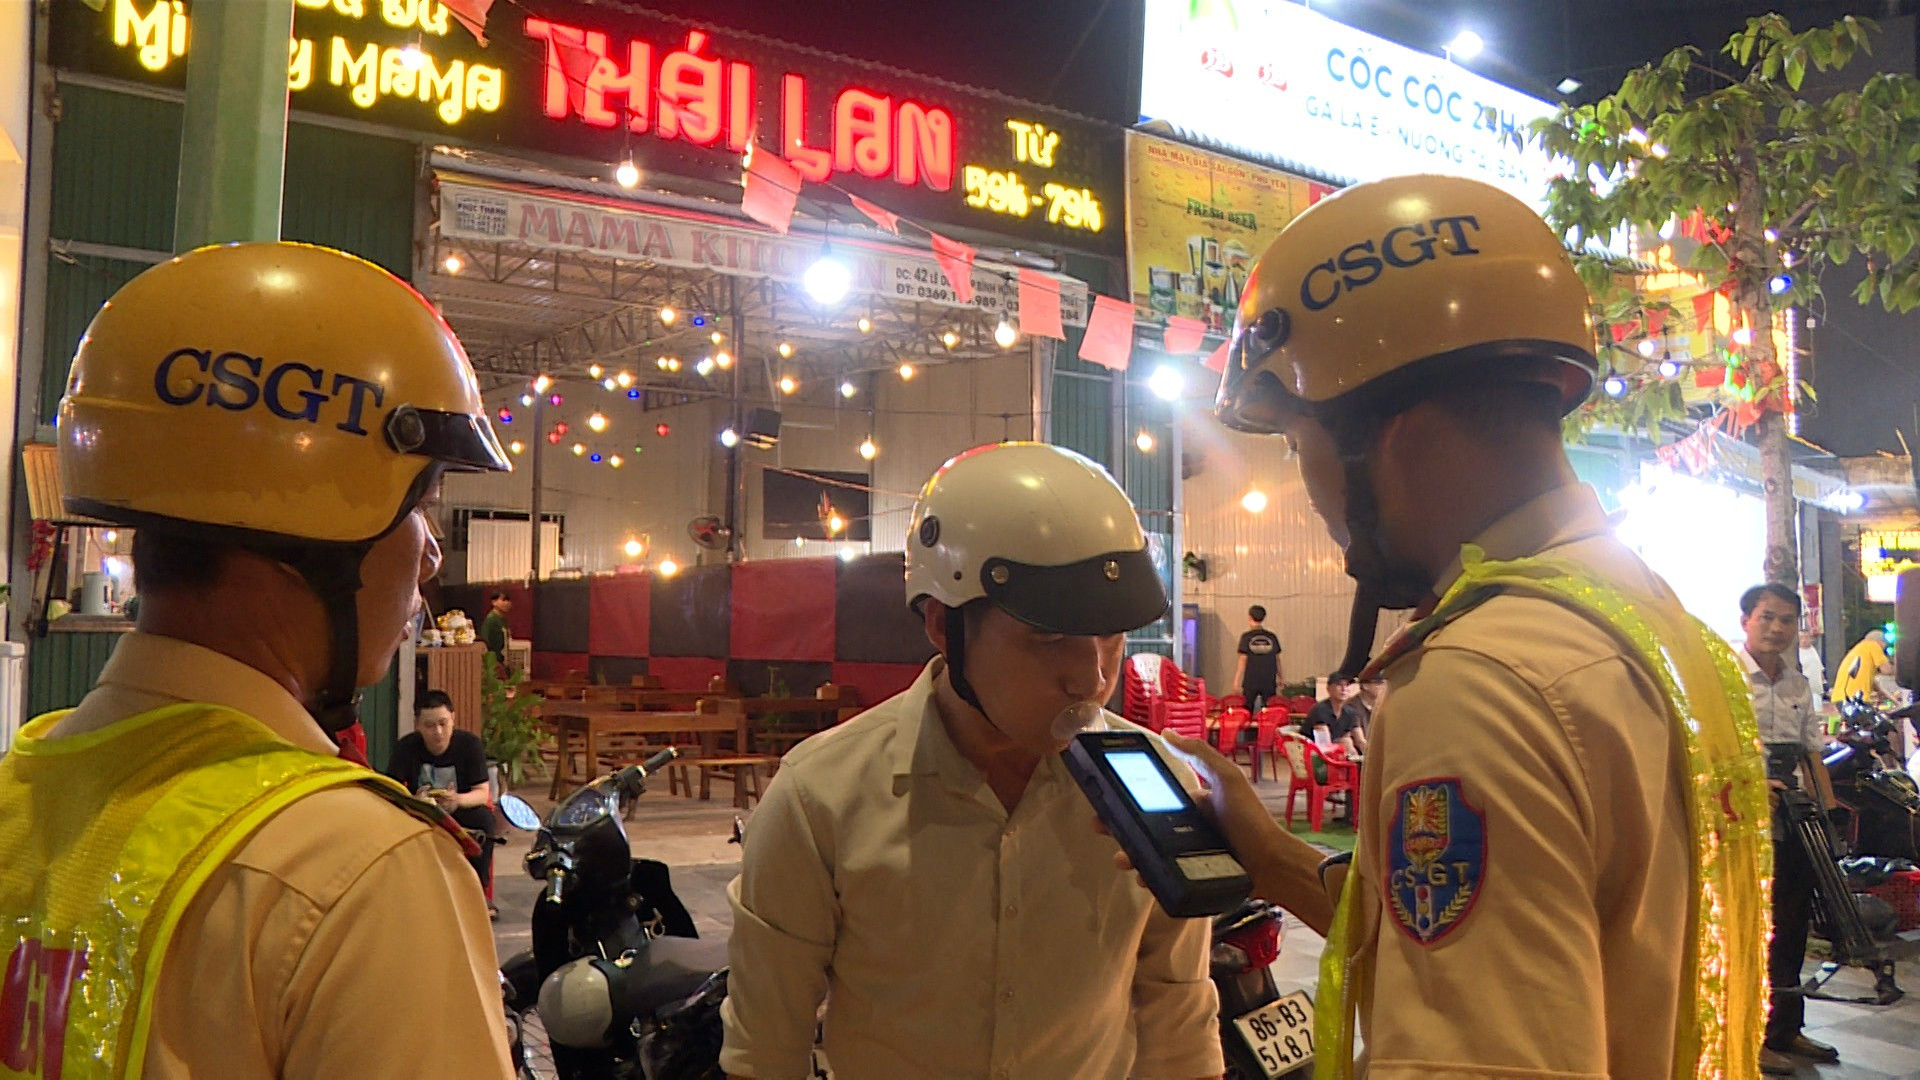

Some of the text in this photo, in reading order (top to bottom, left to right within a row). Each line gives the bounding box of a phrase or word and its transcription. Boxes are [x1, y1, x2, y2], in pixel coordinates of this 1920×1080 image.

[783, 72, 955, 191] LAN
[518, 204, 673, 259] MAMA
[690, 231, 884, 290] KITCN
[914, 267, 928, 283] 42
[1301, 214, 1480, 312] CSGT
[154, 348, 384, 437] CSGT
[1391, 860, 1471, 891] CSGT
[1248, 999, 1307, 1042] 86-B3
